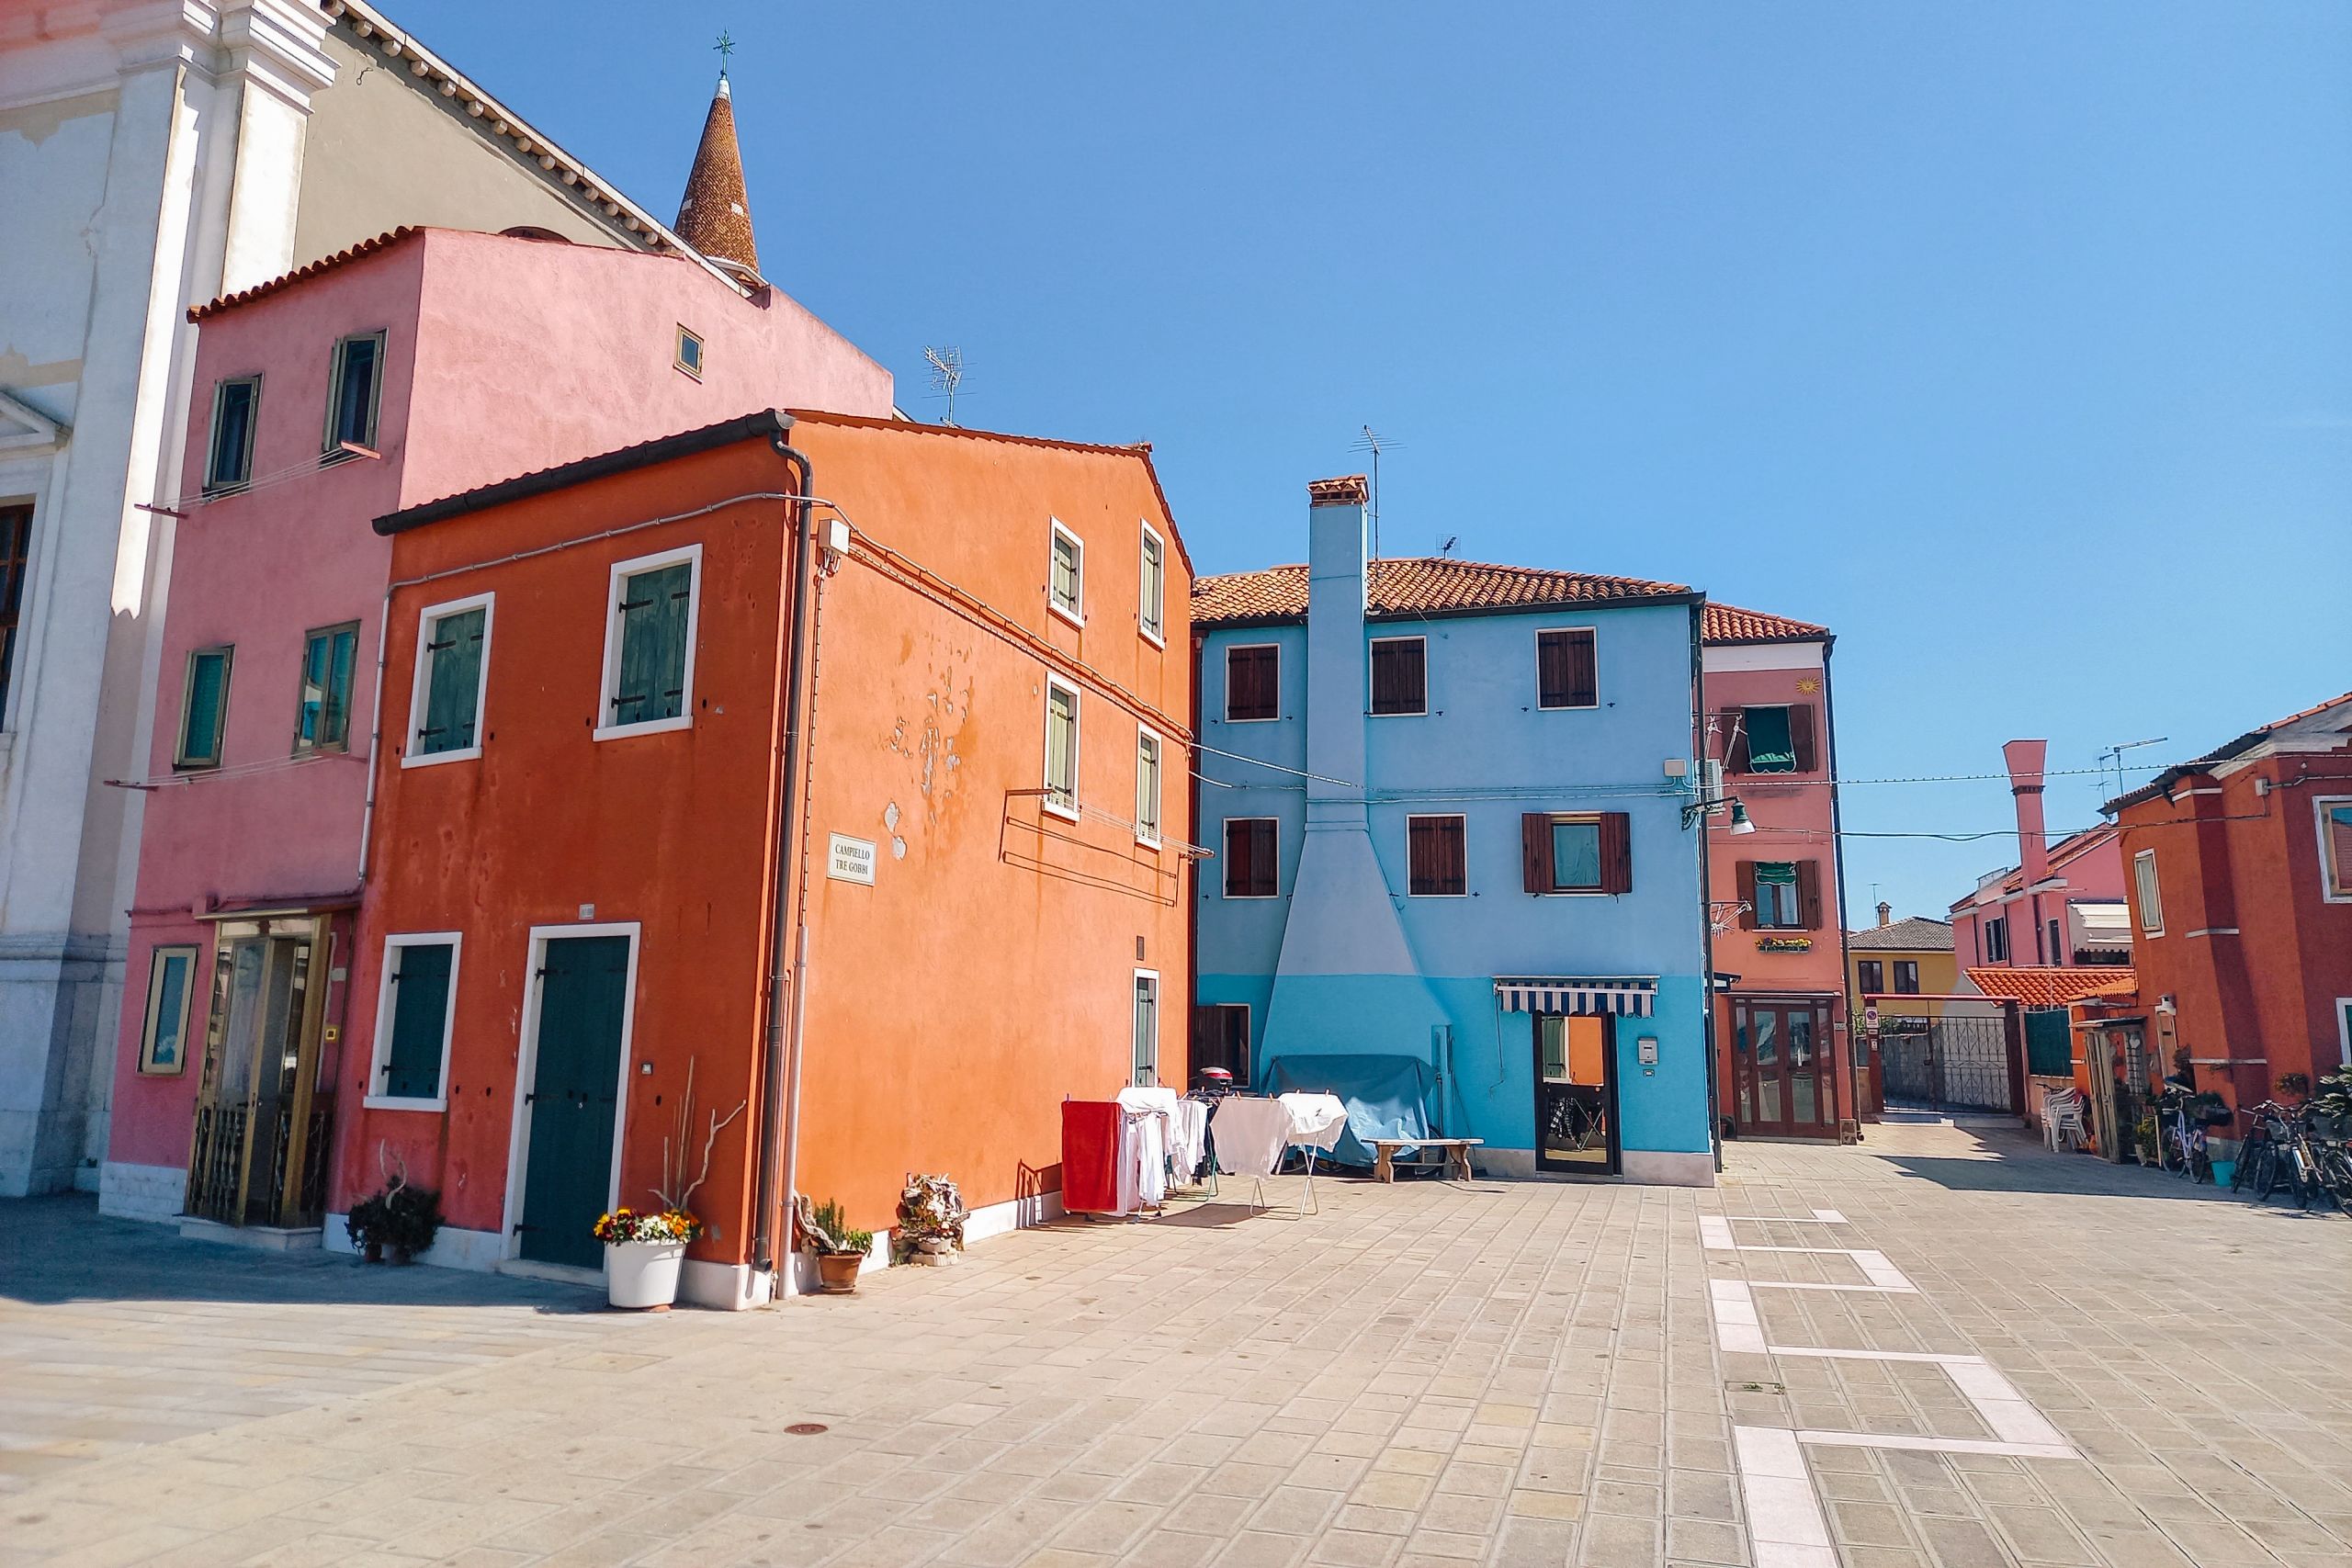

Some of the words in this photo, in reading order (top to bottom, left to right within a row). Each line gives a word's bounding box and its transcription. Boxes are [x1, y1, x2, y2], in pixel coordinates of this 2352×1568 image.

[835, 844, 870, 860] CAMPIELLO
[835, 859, 847, 871] TRE
[849, 862, 868, 874] GOBBI
